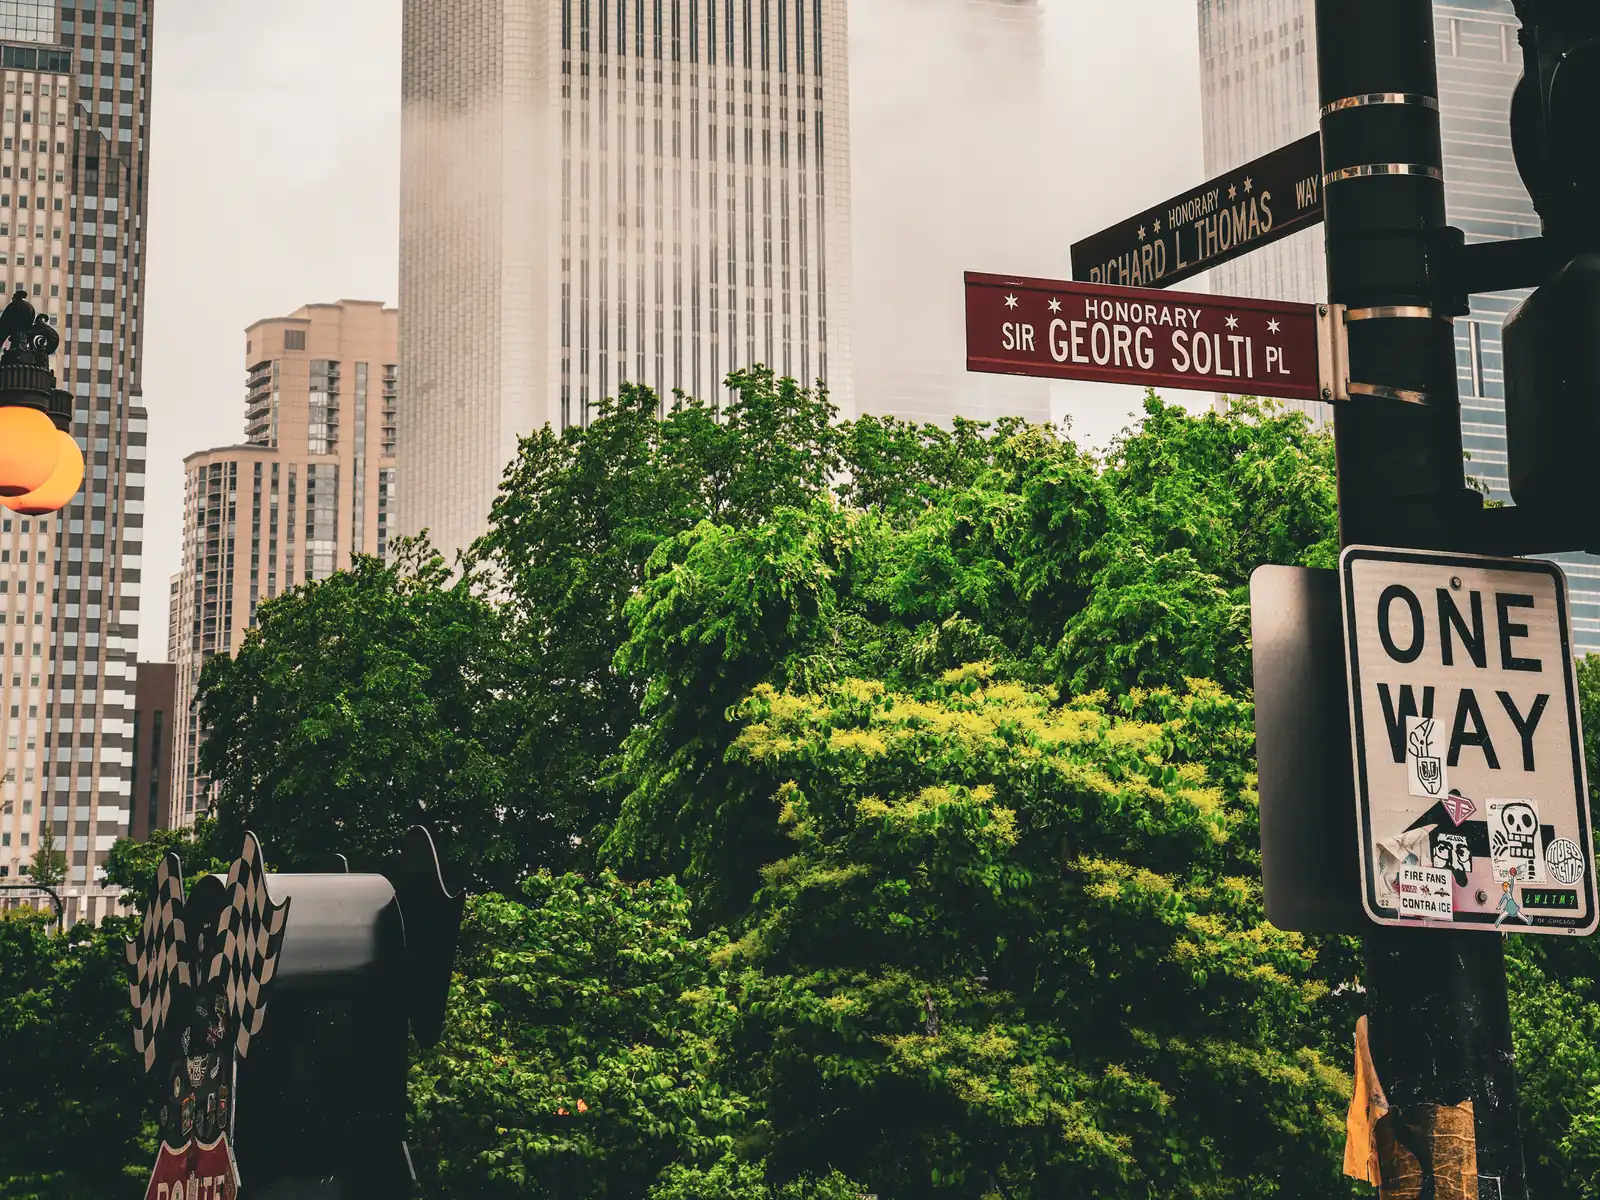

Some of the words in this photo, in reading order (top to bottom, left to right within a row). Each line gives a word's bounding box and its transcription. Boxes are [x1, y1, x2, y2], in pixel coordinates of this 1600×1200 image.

[1168, 188, 1219, 229] HONORARY
[1175, 231, 1187, 270] L
[1194, 191, 1273, 260] THOMAS
[1296, 174, 1319, 210] WAY
[1086, 299, 1202, 329] HONORARY
[1002, 322, 1035, 351] SIR
[1049, 318, 1155, 370] GEORG
[1171, 330, 1253, 378] SOLTI
[1266, 346, 1291, 375] PL
[1377, 584, 1543, 673] ONE
[1377, 682, 1550, 772] WAY
[1404, 870, 1423, 881] FIRE
[1426, 873, 1447, 885] FANS
[1402, 898, 1437, 912] CONTRA
[1438, 902, 1451, 913] ICE
